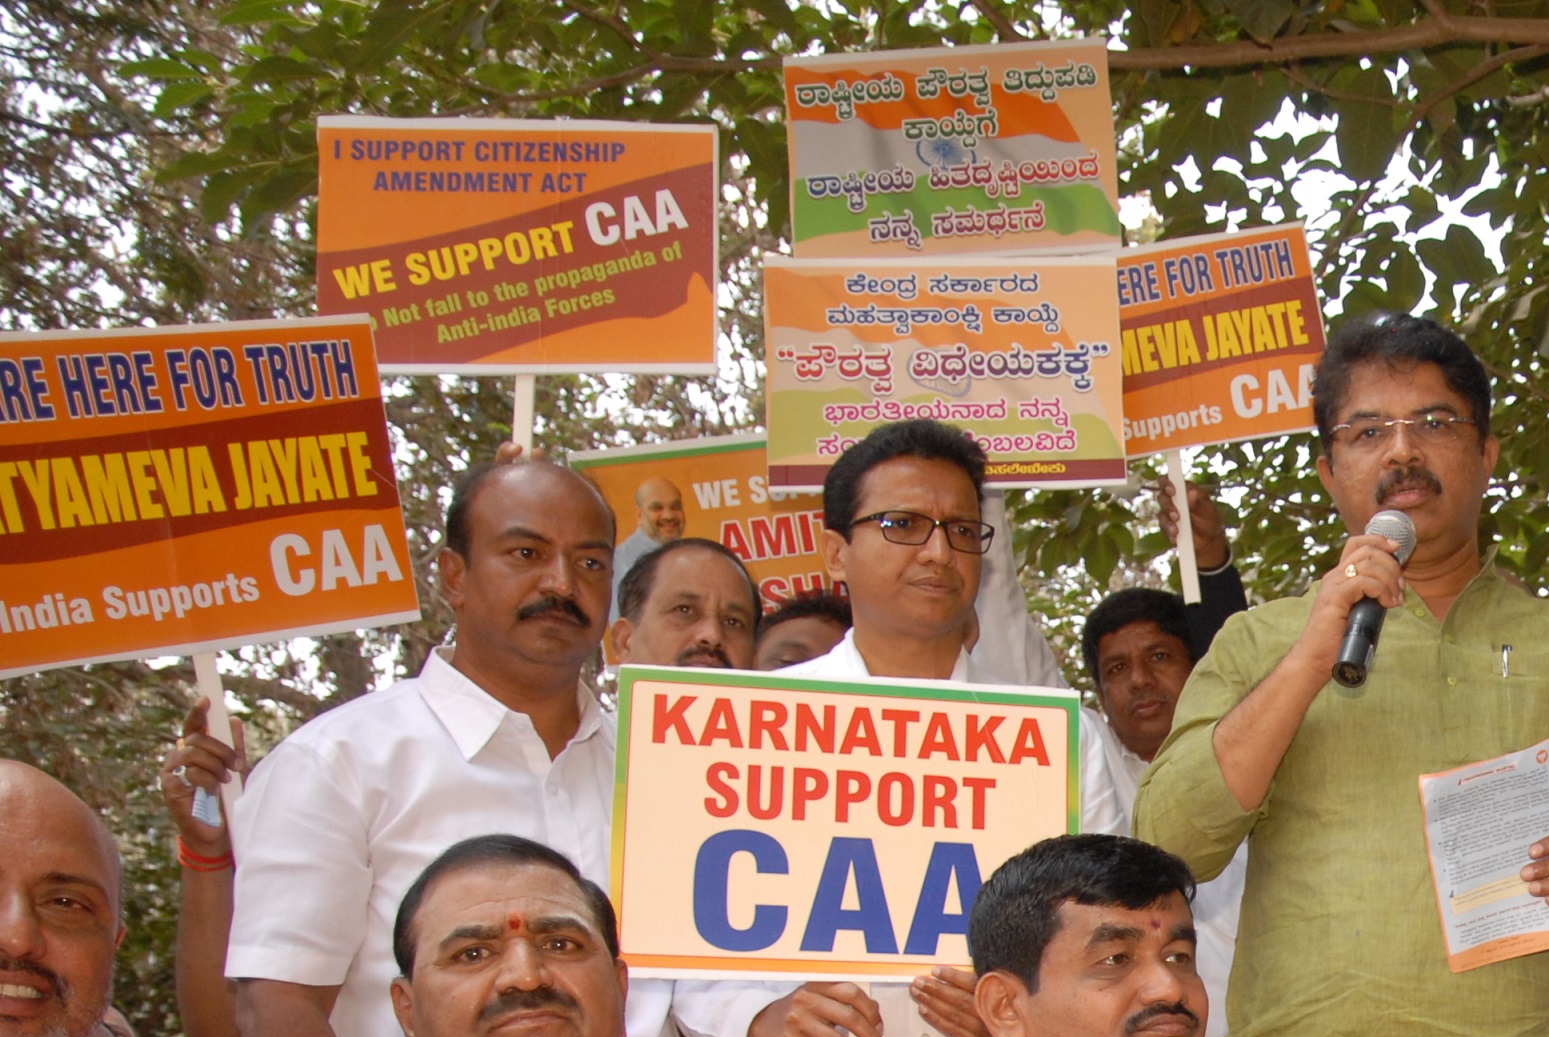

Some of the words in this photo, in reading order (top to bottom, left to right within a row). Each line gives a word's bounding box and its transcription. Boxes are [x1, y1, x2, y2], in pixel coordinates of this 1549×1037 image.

[796, 72, 904, 119] ರಾಷ್ಟ್ರೀಯ
[916, 67, 990, 107] ಪೌರತ್ವ
[1003, 61, 1097, 101] ತಿದ್ದುಪಡಿ
[334, 140, 341, 160] I
[351, 141, 465, 161] SUPPORT
[474, 142, 626, 162] CITIZENSHIP
[904, 107, 998, 148] ಕಾಯ್ದೆಗೆ
[374, 172, 532, 192] AMENDMENT
[541, 173, 586, 193] ACT
[807, 163, 915, 213] ರಾಷ್ಟ್ರೀಯ
[929, 150, 1099, 197] ಹಿತದೃಷ್ಟಿಯಿಂದ
[333, 259, 397, 299] WE
[405, 221, 575, 286] SUPPORT
[585, 188, 689, 246] CAA
[869, 210, 922, 248] ನನ್ನ
[932, 201, 1046, 238] ಸಮರ್ಥನೆ
[383, 303, 421, 328] Not
[425, 293, 462, 318] fall
[466, 290, 489, 309] to
[494, 277, 529, 301] the
[536, 251, 656, 297] propaganda
[662, 241, 683, 261] of
[846, 274, 917, 299] ಕೇಂದ್ರ
[929, 273, 1038, 293] ಸರ್ಕಾರದ
[1117, 263, 1161, 306] ERE
[1164, 253, 1214, 298] FOR
[1215, 239, 1295, 288] TRUTH
[437, 304, 541, 343] Anti-india
[548, 287, 615, 316] Forces
[827, 304, 982, 334] ಮಹತ್ವಾಕಾಂಕ್ಷಿ
[993, 303, 1059, 333] ಕಾಯ್ದೆ
[1121, 319, 1201, 376] MEVA
[1203, 300, 1309, 361] JAYATE
[0, 357, 56, 423] RE
[57, 350, 164, 419] HERE
[165, 347, 244, 411] FOR
[244, 339, 360, 405] TRUTH
[823, 397, 1006, 425] ಭಾರತೀಯನಾದ
[1019, 397, 1069, 427] ನನ್ನ
[1123, 404, 1223, 441] Supports
[0, 445, 227, 535] TYAMEVA
[228, 431, 378, 511] JAYATE
[692, 479, 741, 510] WE
[0, 593, 94, 634] India
[103, 573, 260, 621] Supports
[269, 524, 403, 597] CAA
[651, 694, 1051, 767] KARNATAKA
[703, 762, 997, 830] SUPPORT
[692, 829, 984, 956] CAA
